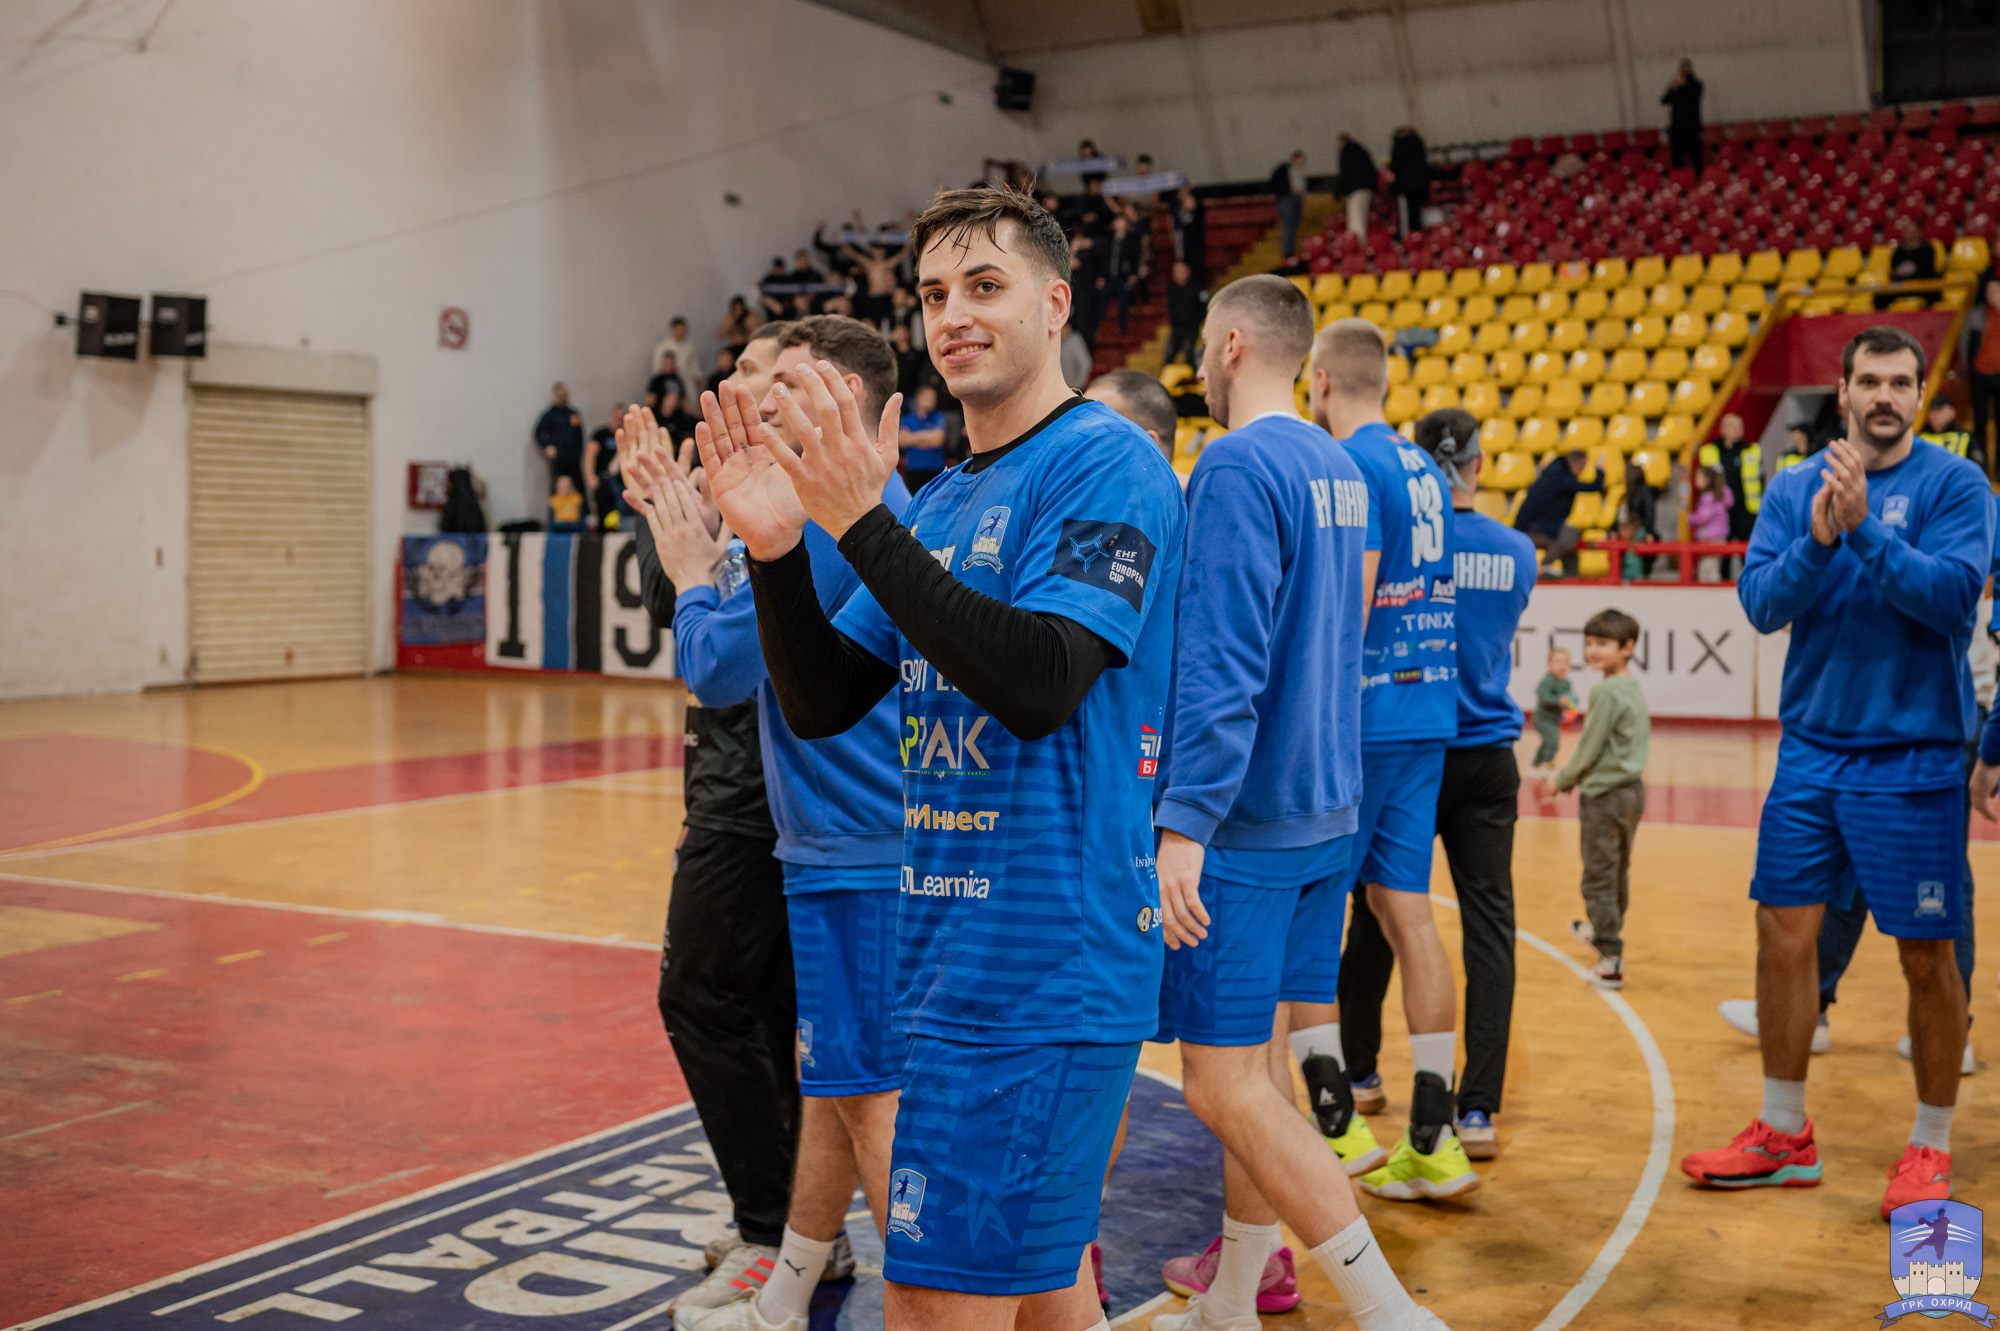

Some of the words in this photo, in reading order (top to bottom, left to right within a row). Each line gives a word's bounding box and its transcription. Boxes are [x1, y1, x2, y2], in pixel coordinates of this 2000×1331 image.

[1115, 549, 1138, 559] EHF
[1109, 570, 1125, 585] CUP
[1110, 561, 1144, 589] EUROPEAN
